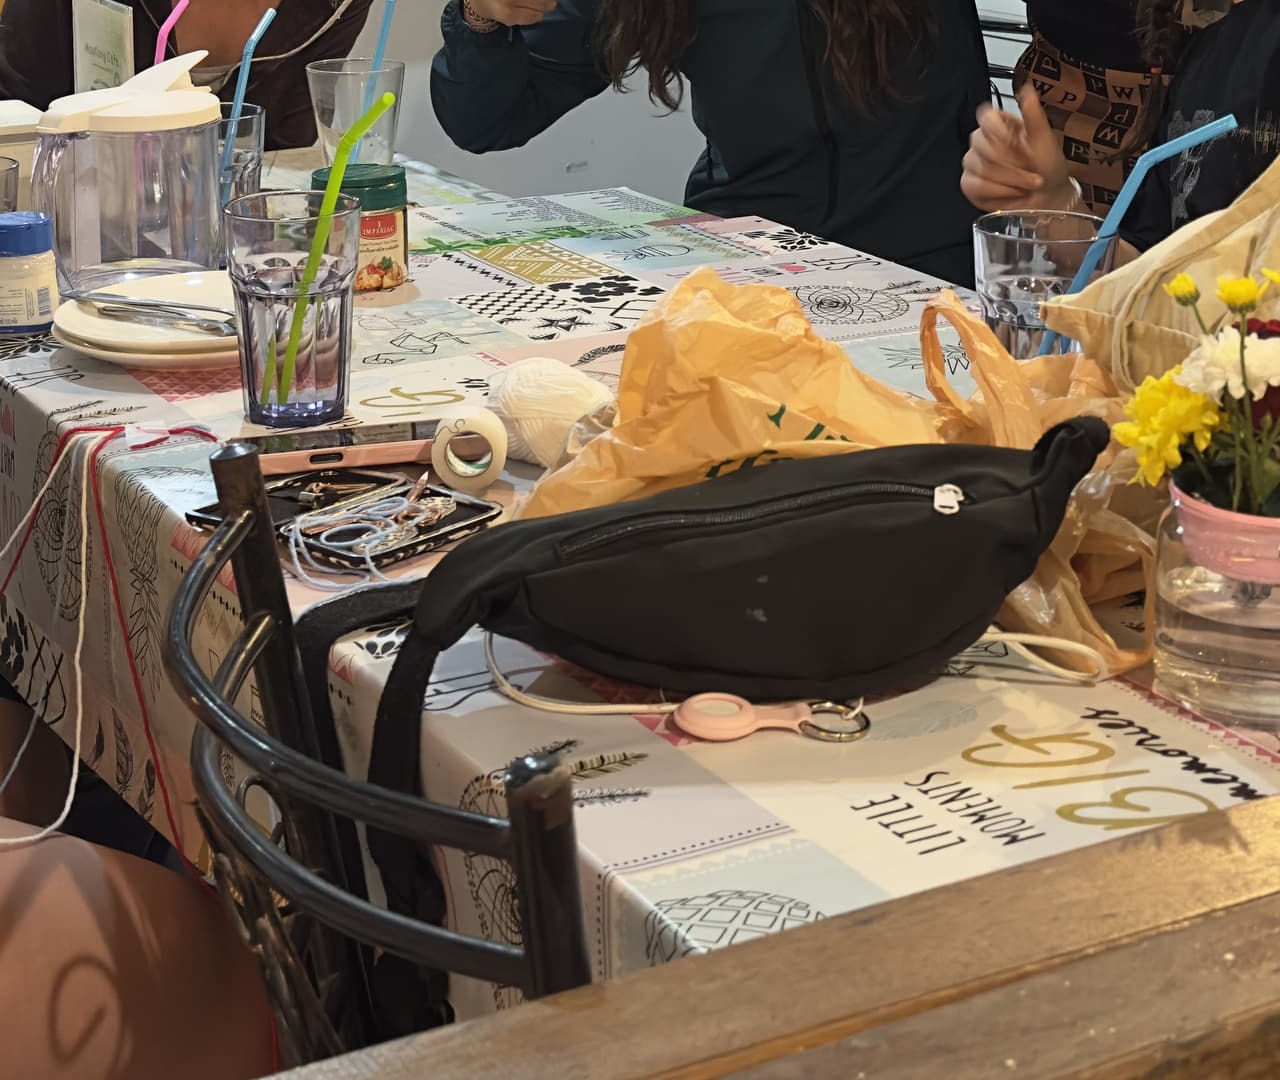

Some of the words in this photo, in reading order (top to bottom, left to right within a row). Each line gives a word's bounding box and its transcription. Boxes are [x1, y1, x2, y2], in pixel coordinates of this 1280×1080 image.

[362, 226, 395, 235] IMPERIAL
[904, 771, 1046, 847] MOMENTS
[960, 724, 1220, 831] BIG
[850, 794, 967, 856] LITTLE
